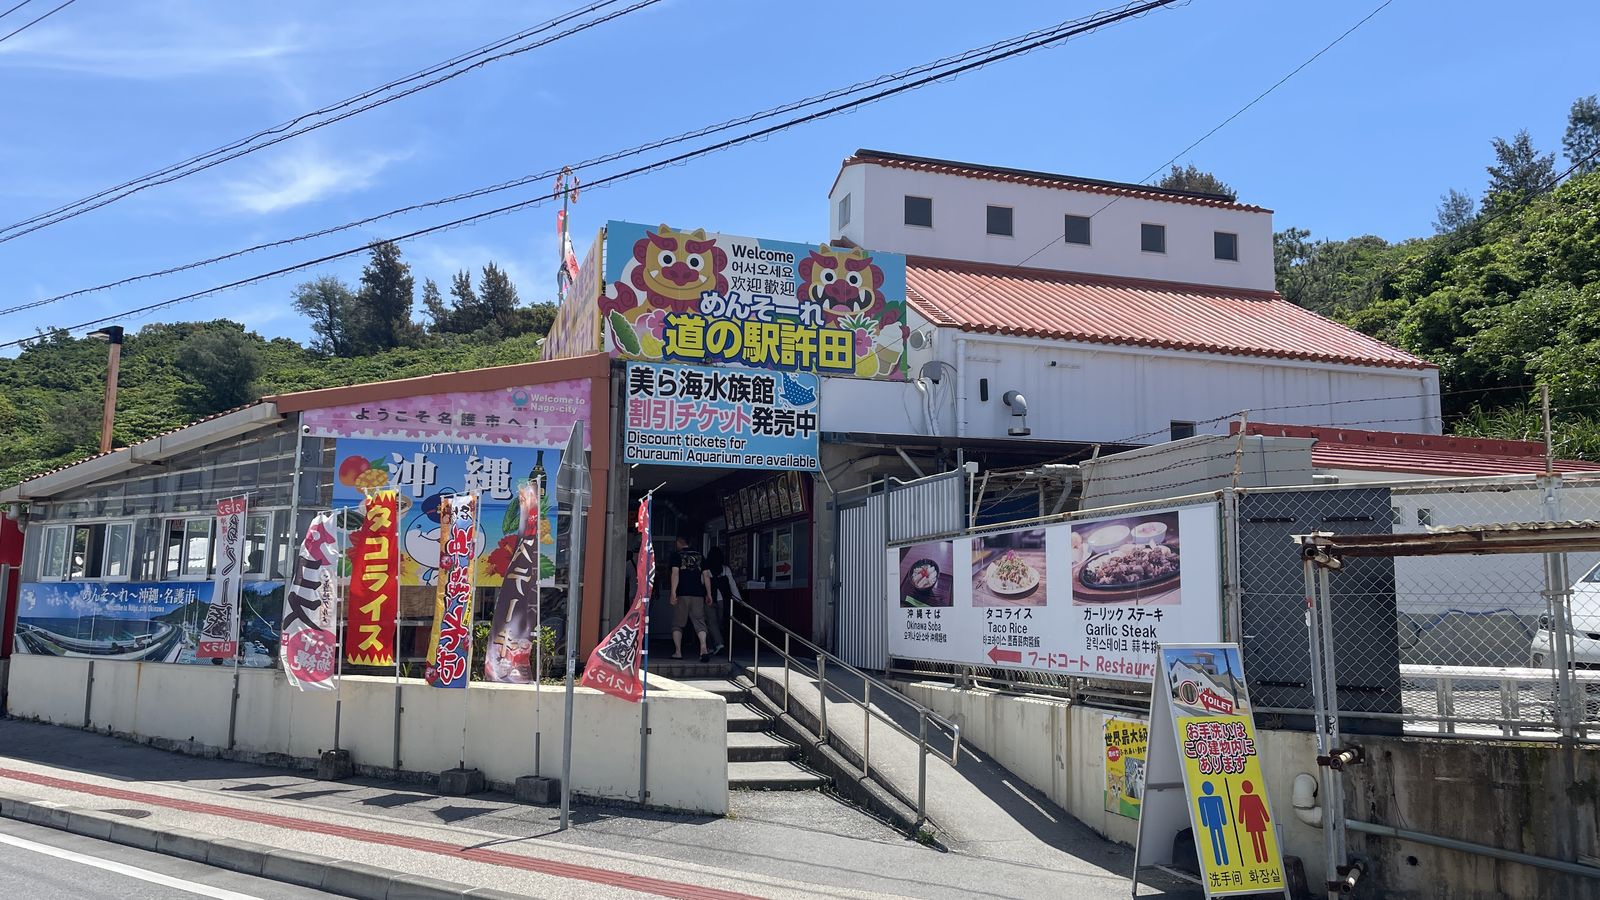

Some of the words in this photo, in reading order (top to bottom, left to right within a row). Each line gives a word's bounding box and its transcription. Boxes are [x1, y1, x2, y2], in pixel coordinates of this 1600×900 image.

[732, 244, 794, 264] Welcome
[731, 261, 794, 279] 어서오세요
[731, 276, 762, 294] 欢迎
[764, 279, 795, 296] 歡迎
[700, 293, 825, 326] めんそーれ
[665, 314, 854, 369] 道の駅許田
[629, 366, 775, 405] 美ら海水族館
[531, 393, 574, 404] Welcome
[576, 396, 585, 405] to
[422, 442, 478, 455] OKINAWA
[627, 431, 682, 446] Discount
[684, 434, 727, 448] tickets
[729, 436, 746, 449] for
[627, 446, 683, 461] Churaumi
[686, 449, 741, 465] Aquarium
[744, 453, 763, 465] are
[767, 453, 816, 468] available
[387, 452, 513, 499] 沖縄
[358, 504, 392, 652] タコライス
[986, 608, 1033, 620] タコライス
[1084, 607, 1124, 621] ガーリック
[1127, 608, 1163, 622] ステーキ
[906, 620, 927, 631] Okinawa
[928, 621, 942, 631] Soba
[988, 622, 1007, 633] Taco
[1009, 623, 1028, 634] Rice
[1086, 623, 1118, 636] Garlic
[1122, 625, 1157, 638] Steak
[1086, 637, 1128, 652] 갈릭스테이크
[1028, 651, 1090, 672] フードコート
[1203, 694, 1232, 711] TOILET
[1187, 721, 1246, 739] お手洗いは
[1185, 739, 1256, 757] この建物内に
[1200, 757, 1247, 774] あります
[1209, 871, 1242, 887] 洗手间
[1249, 868, 1281, 884] 화장실
